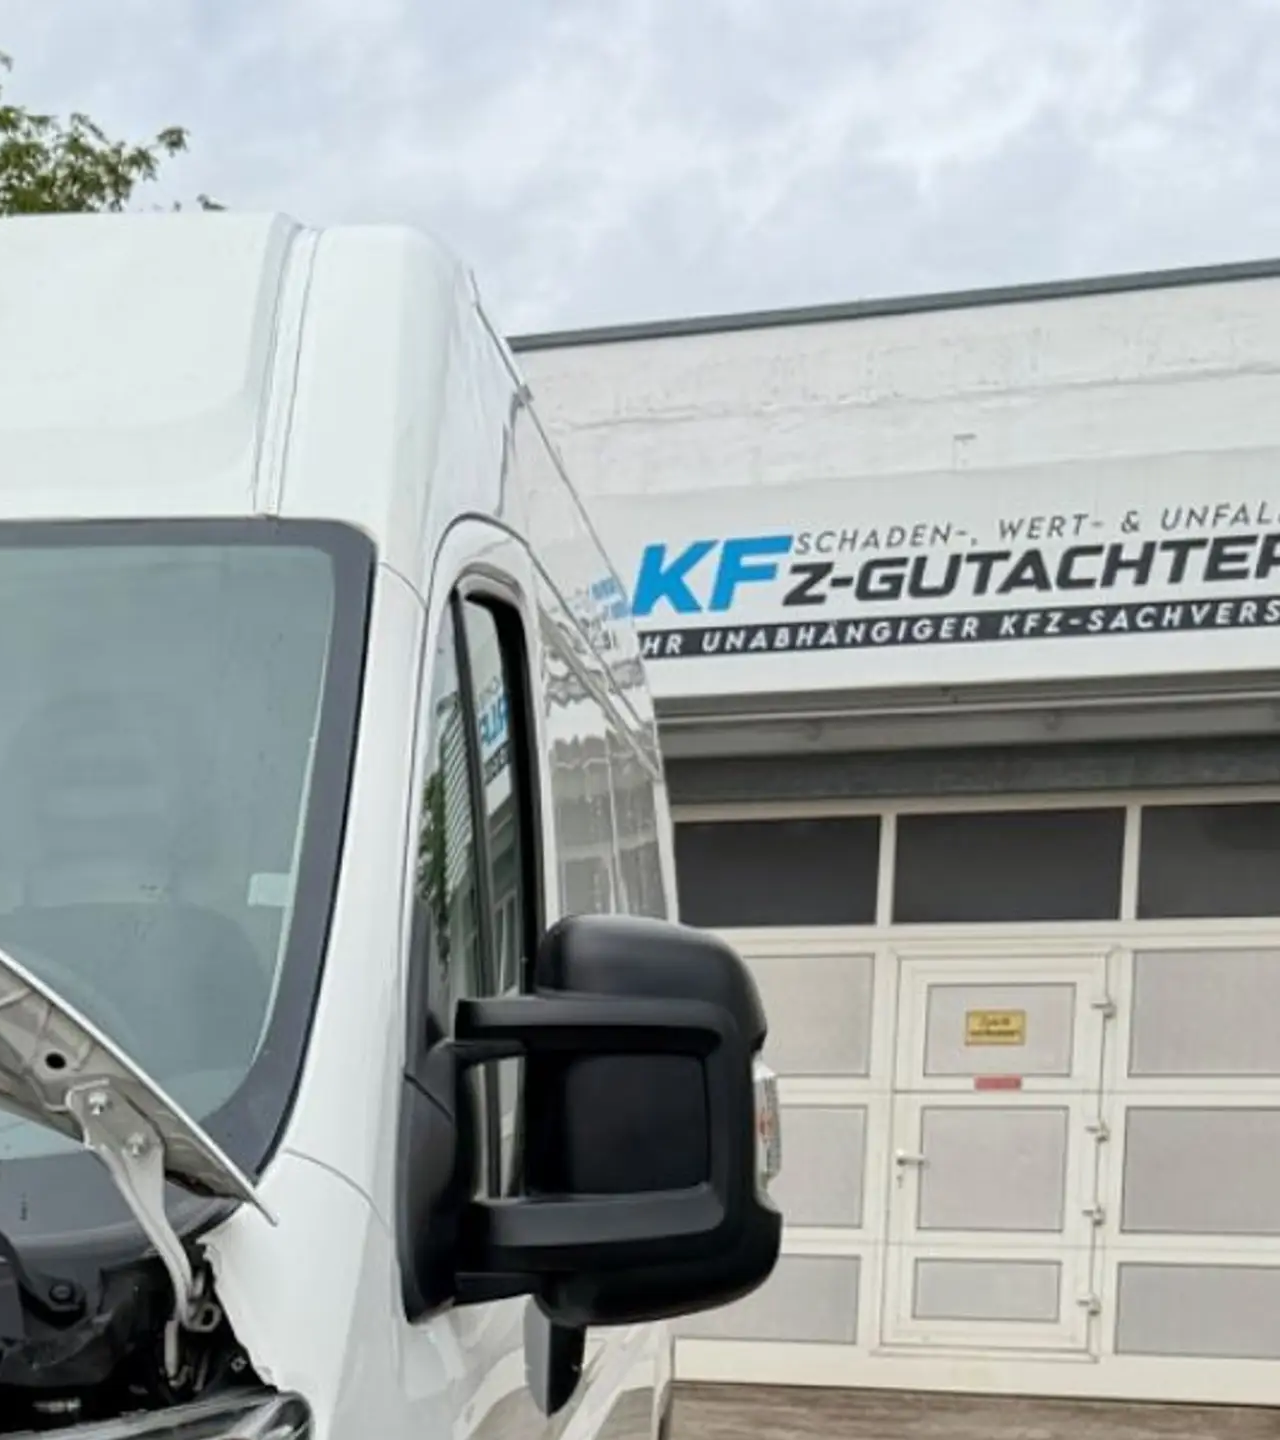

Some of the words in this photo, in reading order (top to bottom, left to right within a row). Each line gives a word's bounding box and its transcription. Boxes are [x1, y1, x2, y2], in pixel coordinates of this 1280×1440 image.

[998, 512, 1105, 542] WERT-
[1120, 509, 1140, 535] &
[1160, 500, 1280, 532] UNFAL
[701, 614, 980, 653] UNABHÄNGIGER
